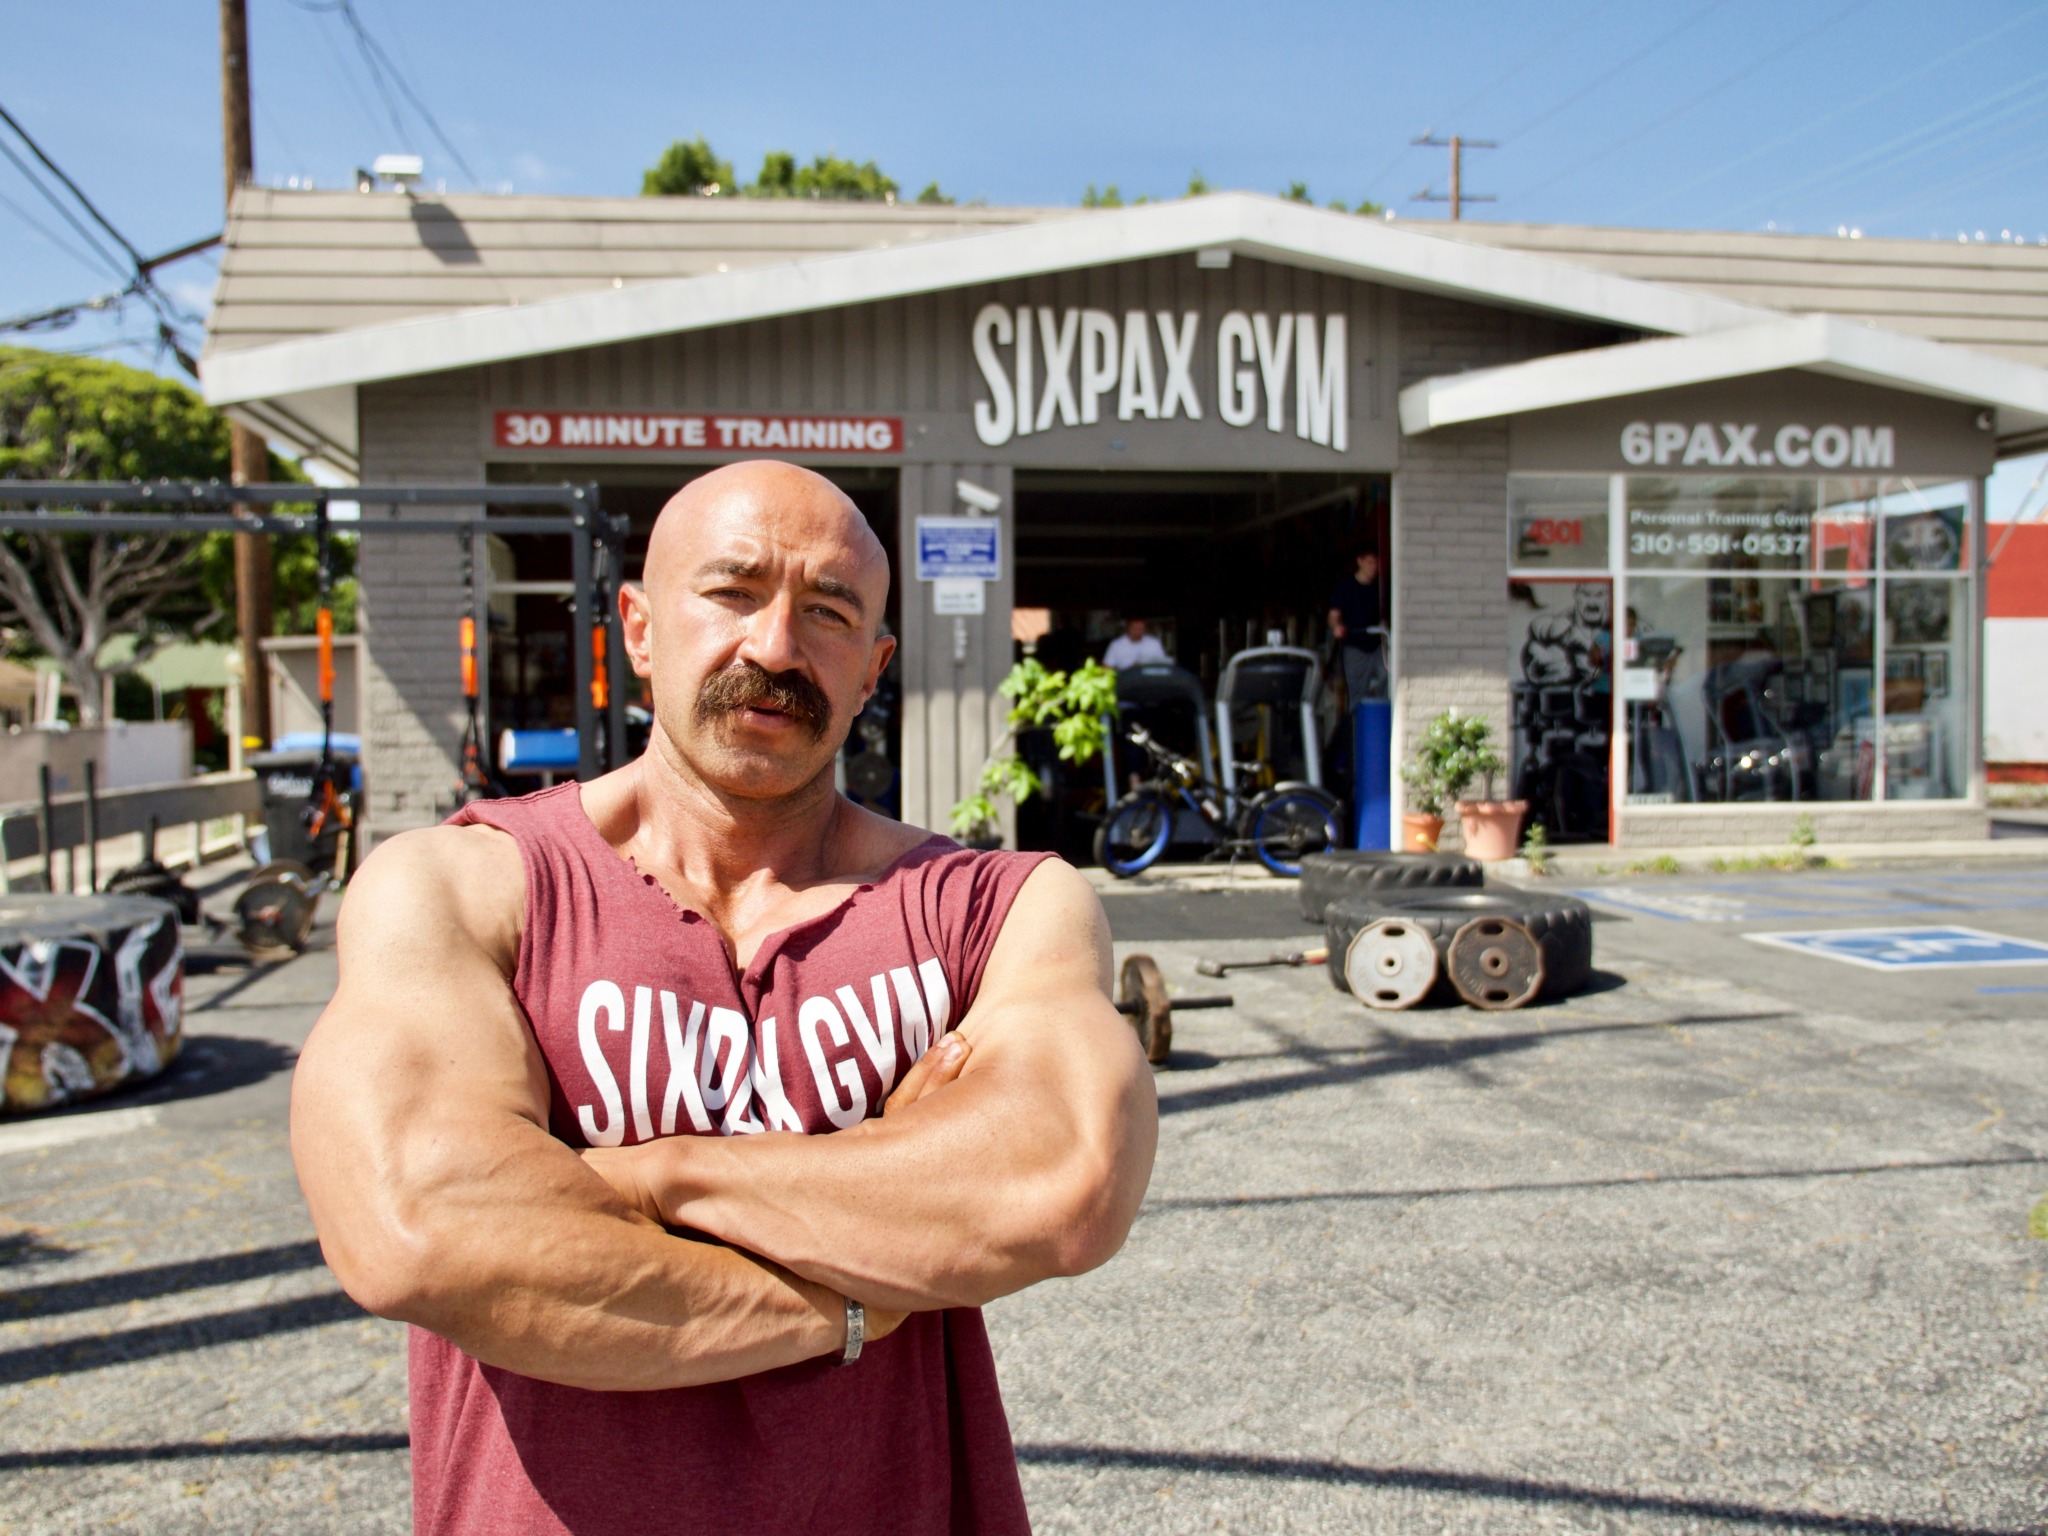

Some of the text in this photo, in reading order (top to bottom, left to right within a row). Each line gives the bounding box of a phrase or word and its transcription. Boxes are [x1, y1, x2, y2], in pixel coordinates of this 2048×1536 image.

[972, 303, 1347, 452] SIXPAX GYM
[506, 415, 893, 449] 30 MINUTE TRAINING
[1619, 421, 1895, 468] 6PAX.COM
[1630, 509, 1700, 525] Personal
[1706, 510, 1770, 527] Training
[1773, 511, 1809, 528] Gym
[798, 957, 951, 1131] GYM
